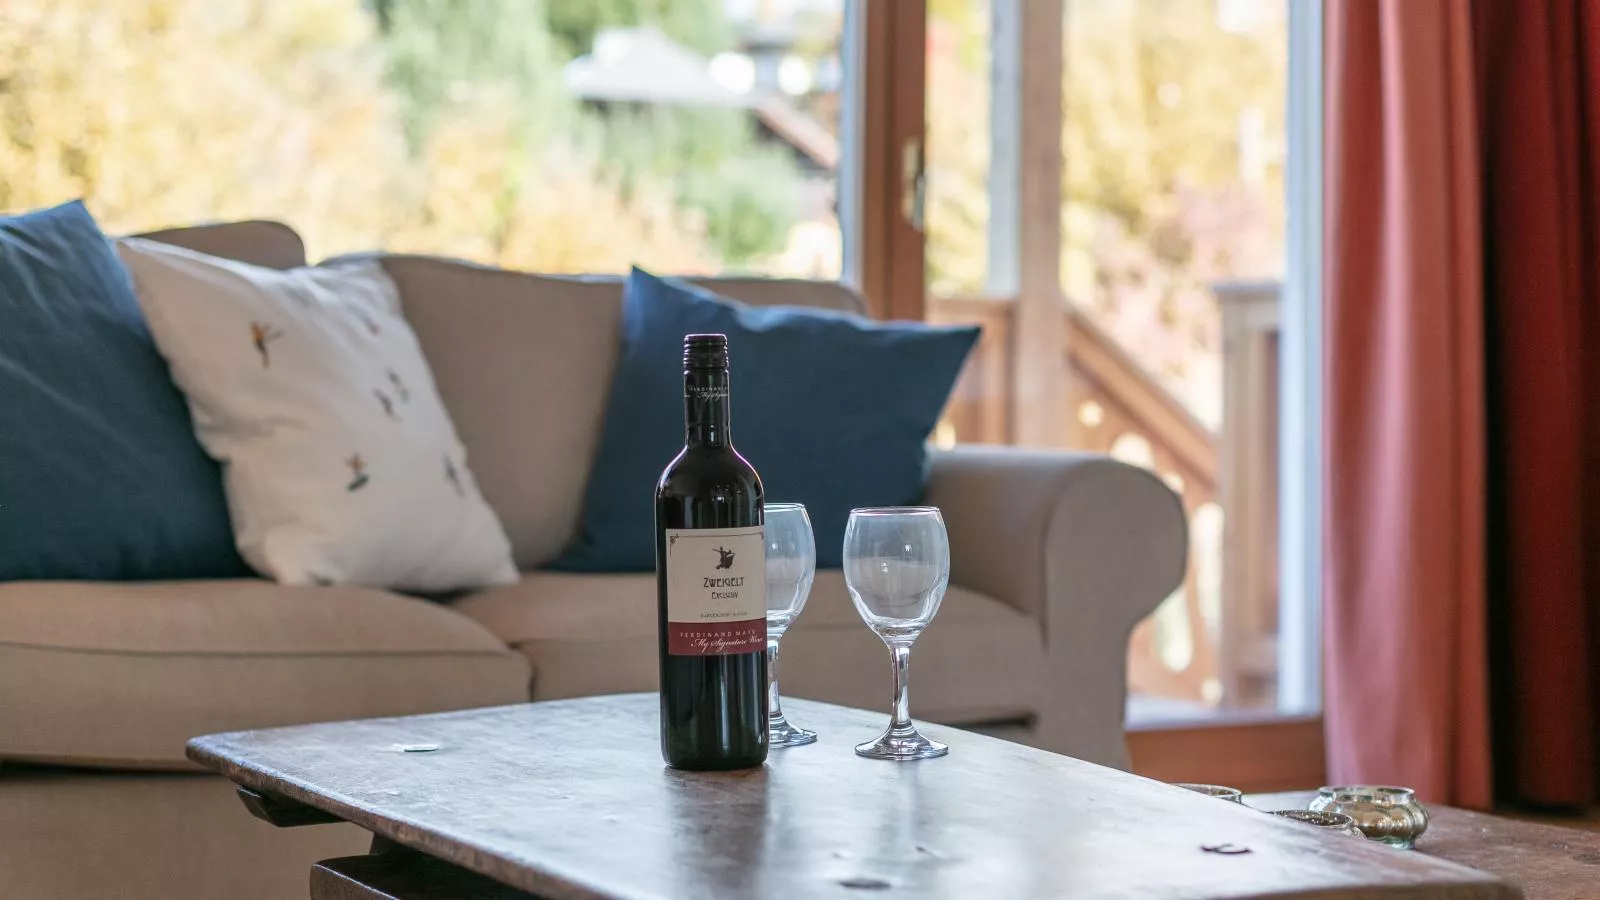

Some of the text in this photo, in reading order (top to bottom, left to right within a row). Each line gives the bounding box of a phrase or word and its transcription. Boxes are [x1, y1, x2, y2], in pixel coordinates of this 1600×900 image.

[703, 577, 745, 588] ZWEIGELT
[690, 638, 709, 653] My
[710, 638, 747, 652] Signature
